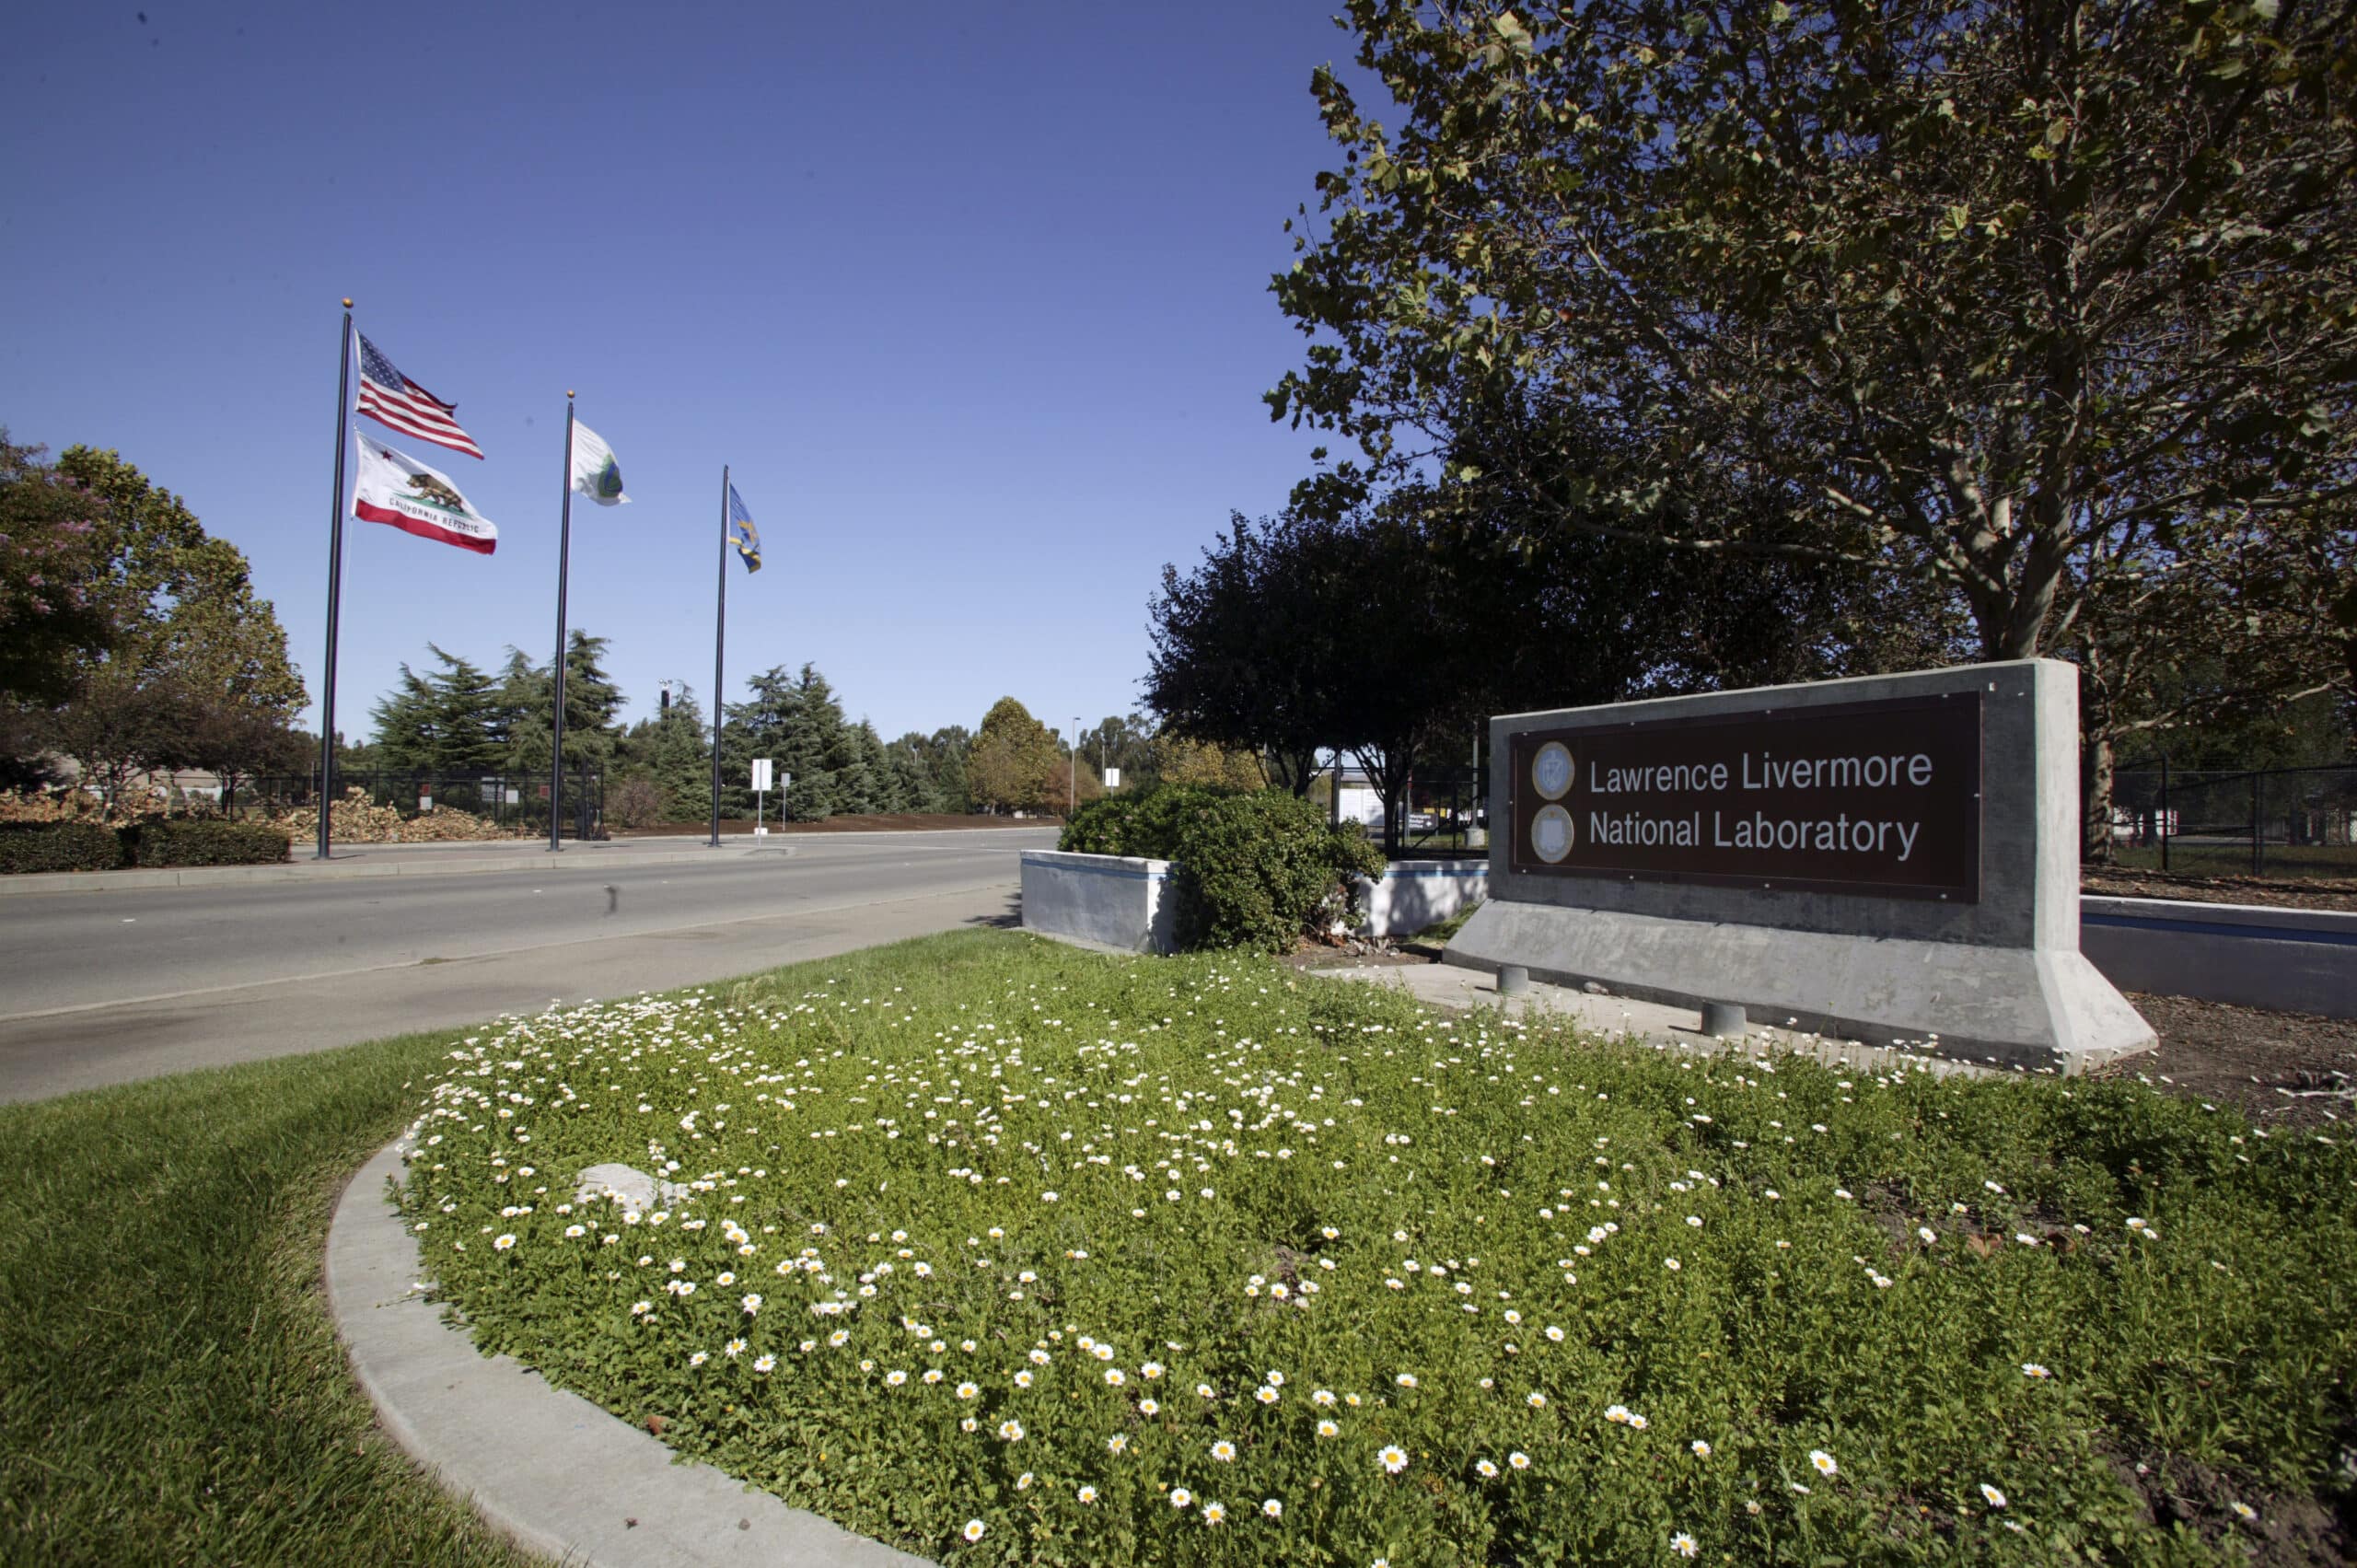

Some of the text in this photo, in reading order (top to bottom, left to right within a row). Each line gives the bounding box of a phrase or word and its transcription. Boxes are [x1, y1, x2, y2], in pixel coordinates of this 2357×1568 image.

[389, 498, 438, 521] CALIFORNIA
[1591, 761, 1728, 793] Lawrence
[1742, 751, 1933, 789] Livermore
[1589, 810, 1700, 846] National
[1714, 811, 1921, 861] Laboratory
